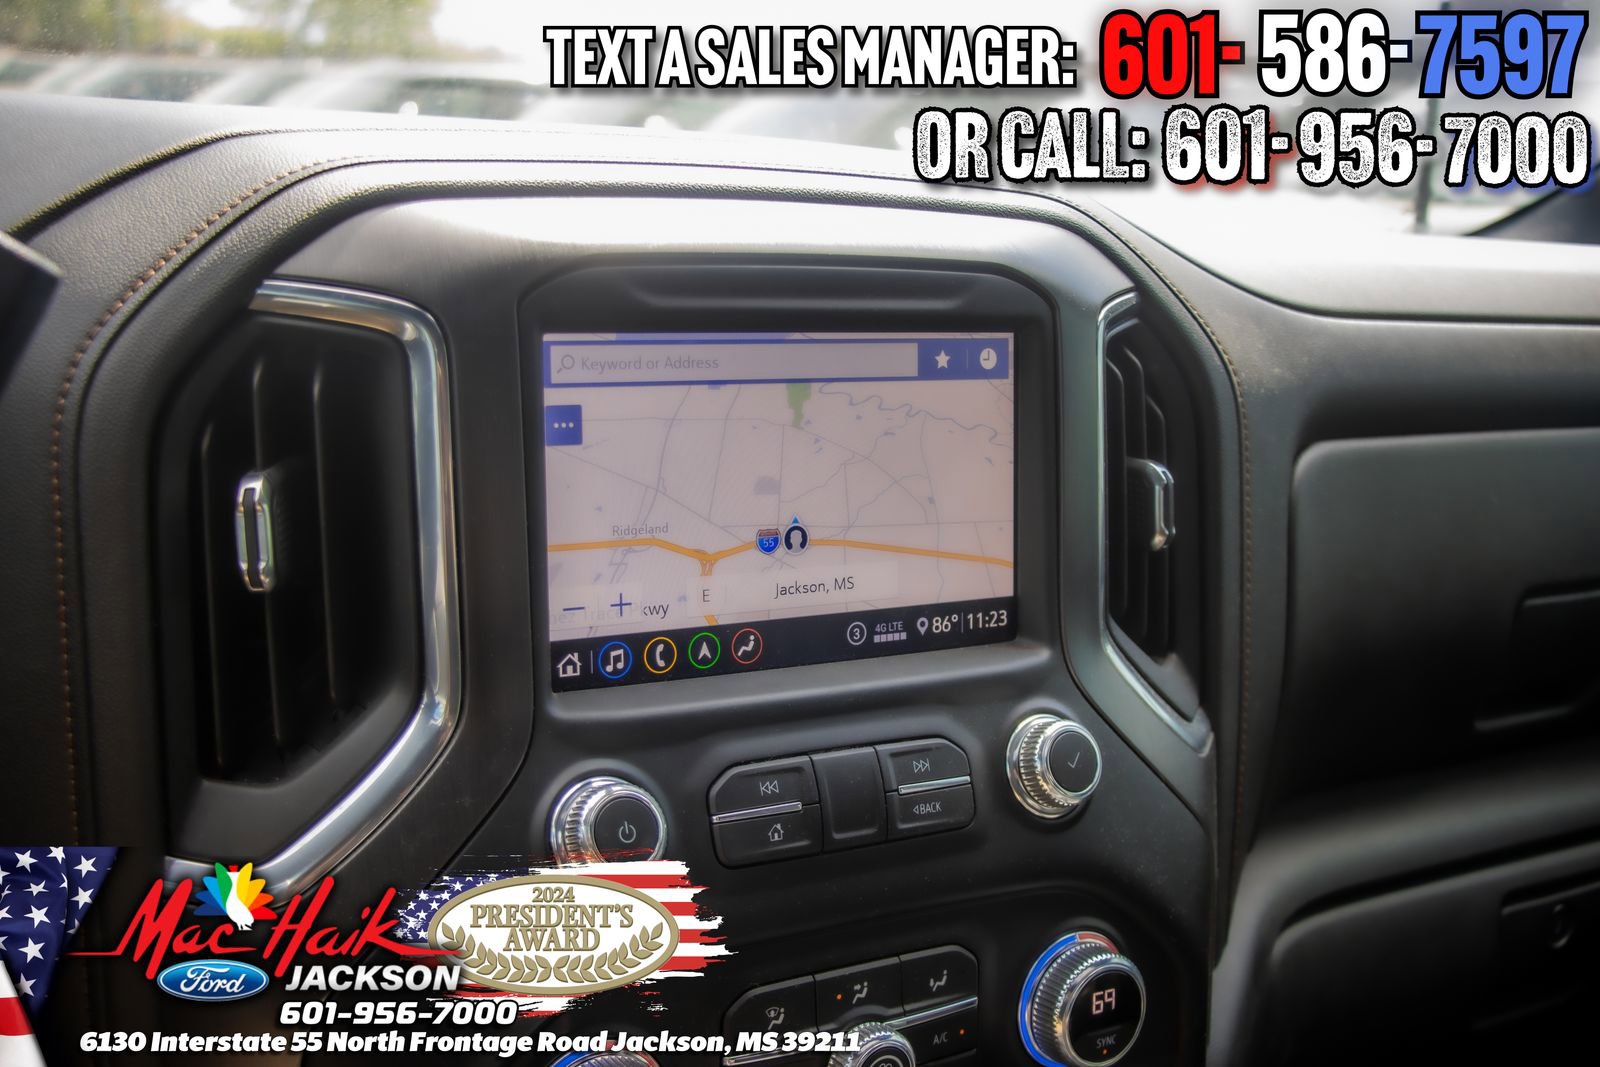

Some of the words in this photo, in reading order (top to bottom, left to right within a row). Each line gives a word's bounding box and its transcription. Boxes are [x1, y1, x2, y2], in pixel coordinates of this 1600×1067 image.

[580, 356, 642, 374] Keyword
[645, 359, 660, 370] or
[664, 355, 719, 370] Address
[612, 522, 669, 538] Ridgeland
[762, 537, 775, 548] 55
[701, 588, 712, 603] E
[774, 580, 830, 600] Jackson,
[834, 576, 855, 591] MS
[874, 623, 887, 633] 4G
[888, 621, 904, 631] LTE
[932, 613, 959, 634] 86°
[967, 609, 1008, 630] 11:23
[852, 627, 861, 641] 3
[919, 801, 942, 815] BACK
[1092, 988, 1116, 1015] 69
[932, 1031, 949, 1046] A/C
[1096, 1033, 1118, 1049] SYNC
